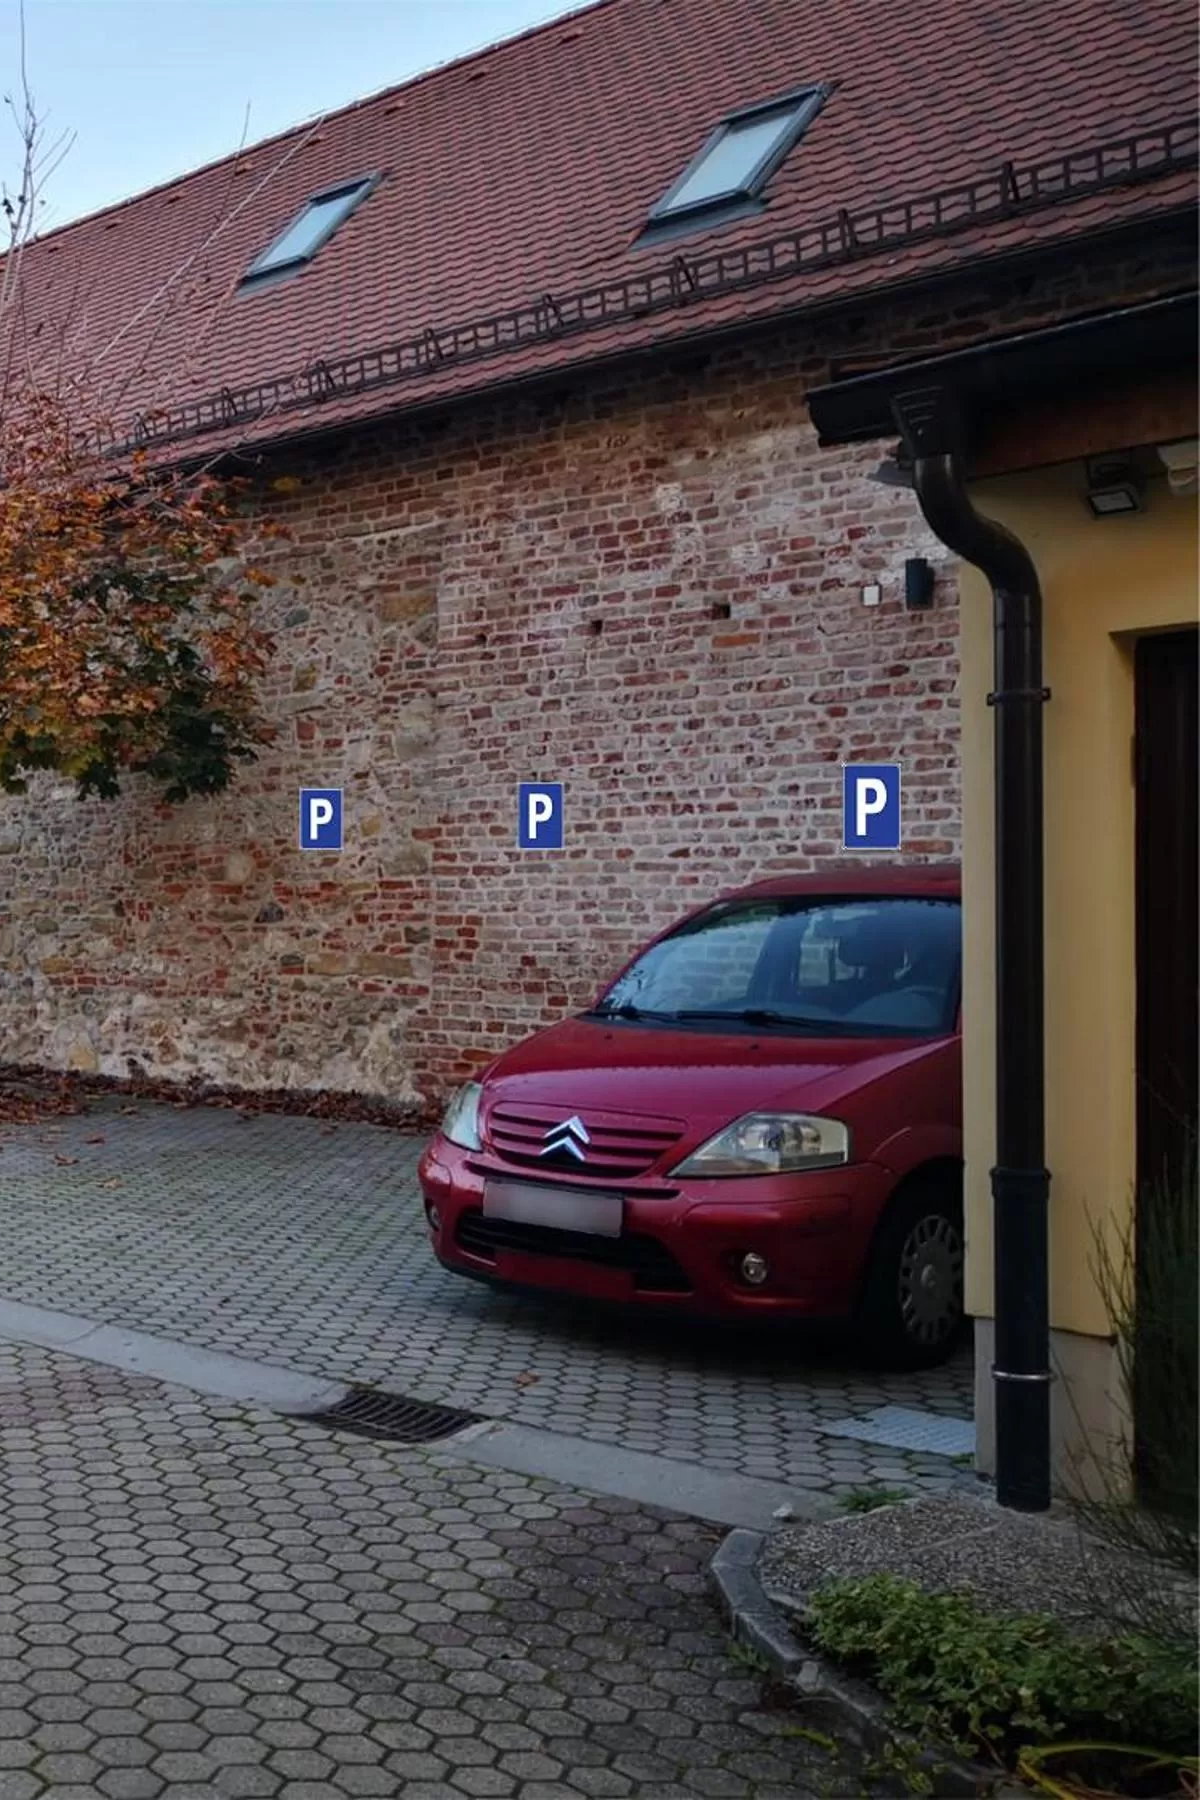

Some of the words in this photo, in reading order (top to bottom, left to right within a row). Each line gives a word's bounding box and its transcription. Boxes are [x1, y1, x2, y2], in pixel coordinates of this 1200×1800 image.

[309, 797, 334, 840] P
[528, 792, 554, 839] P
[856, 777, 888, 836] P
